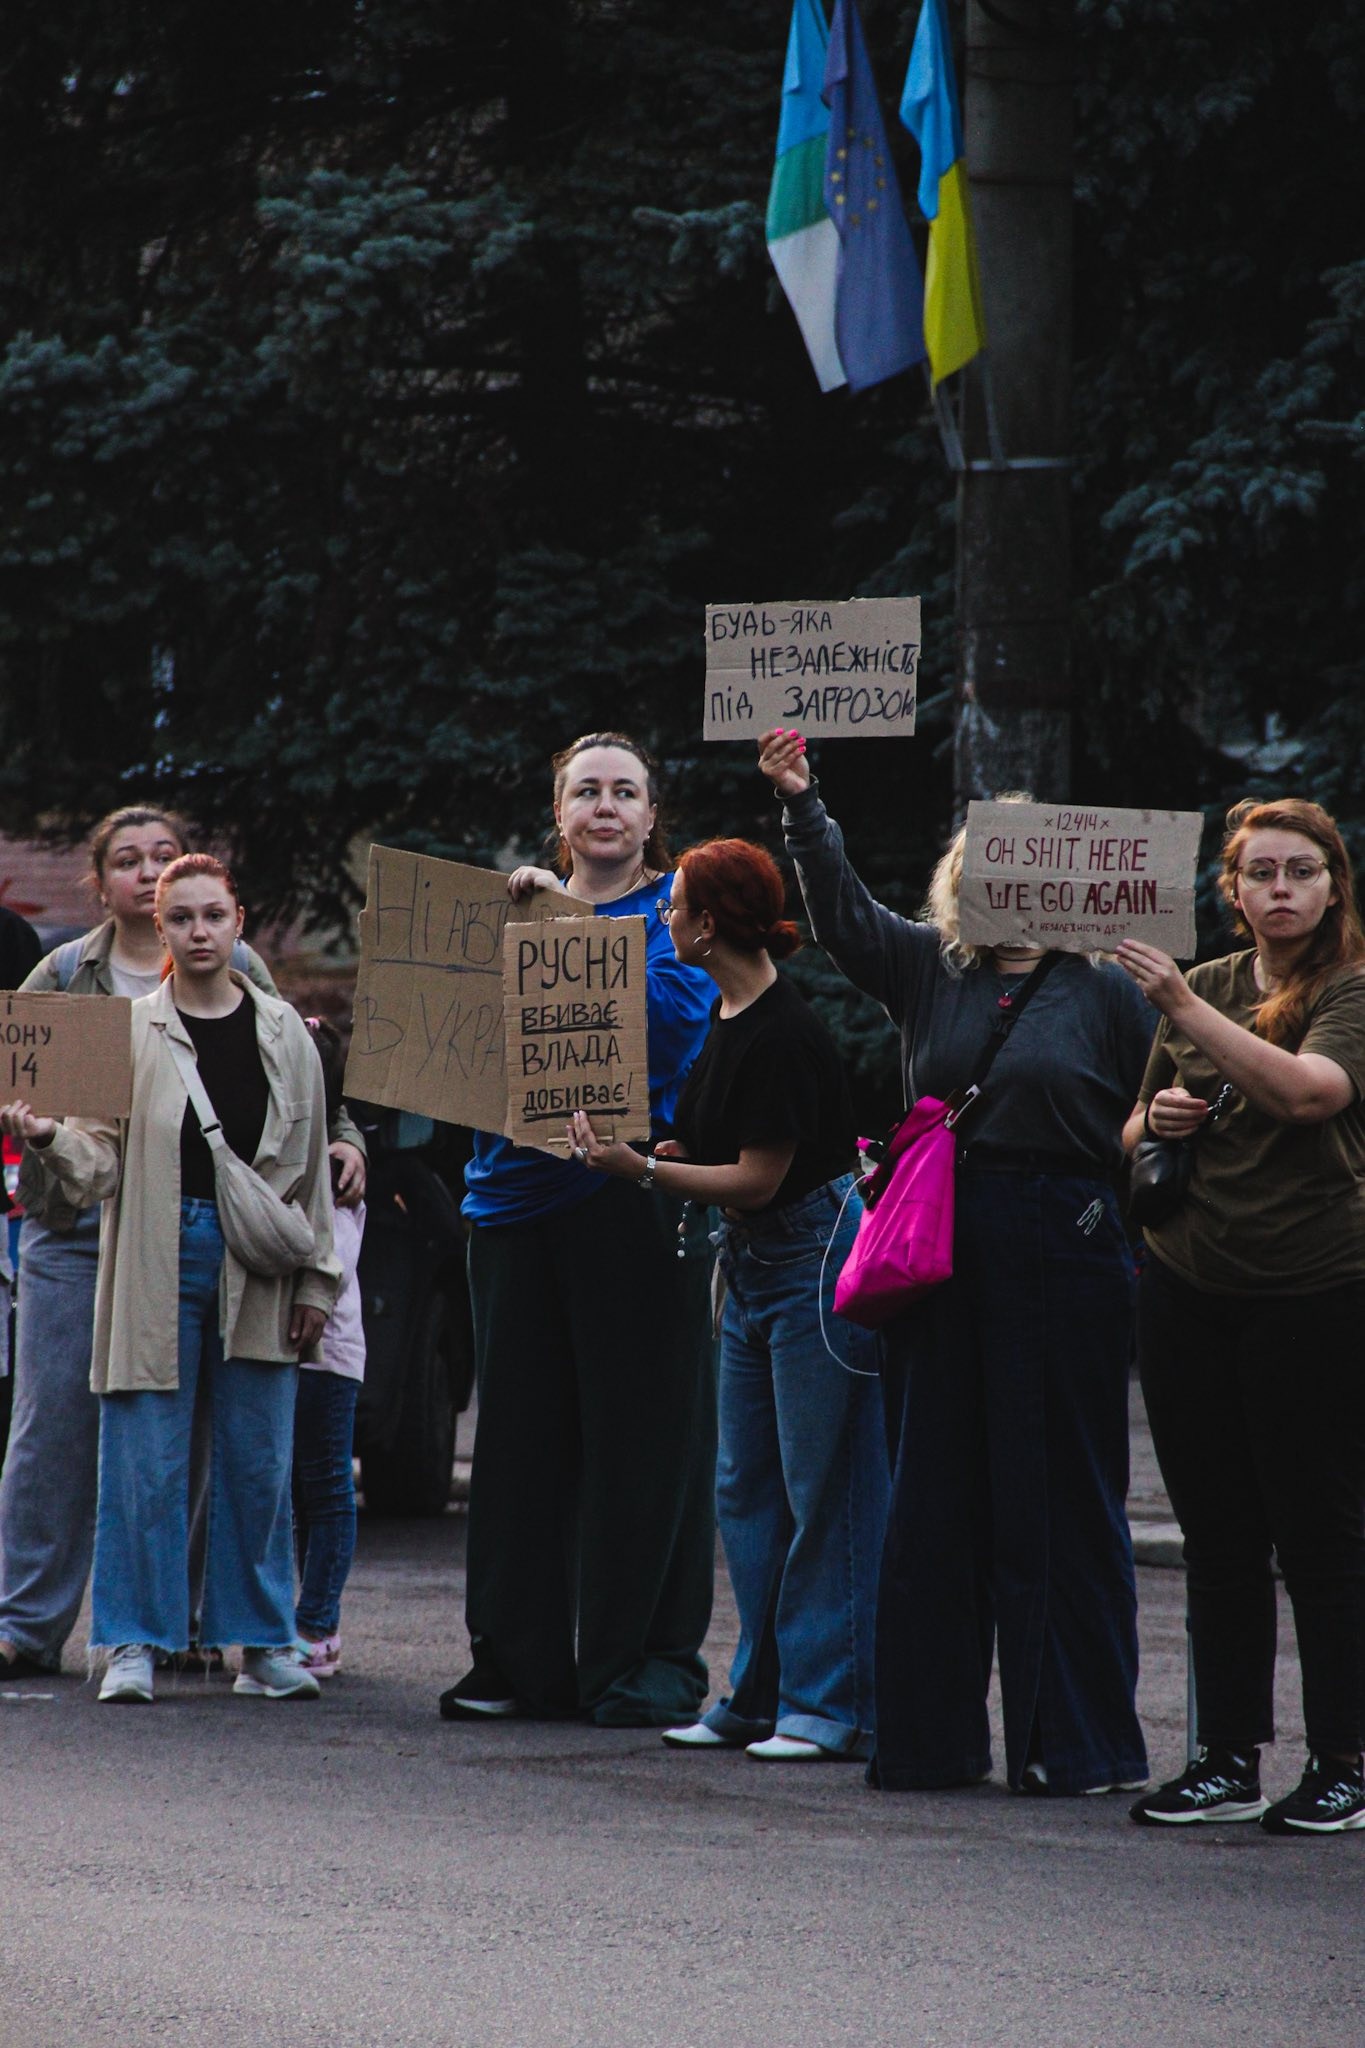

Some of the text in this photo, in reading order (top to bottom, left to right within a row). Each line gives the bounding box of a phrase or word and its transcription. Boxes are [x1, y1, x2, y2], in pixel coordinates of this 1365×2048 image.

[712, 609, 832, 641] БУДЬ-ЯКА
[985, 837, 1015, 864] OH
[1088, 838, 1148, 871] HERE
[985, 882, 1031, 911] WE
[1040, 881, 1074, 912] GO
[518, 935, 628, 996] РУСНЯ
[522, 1035, 621, 1076] ВЛАДА
